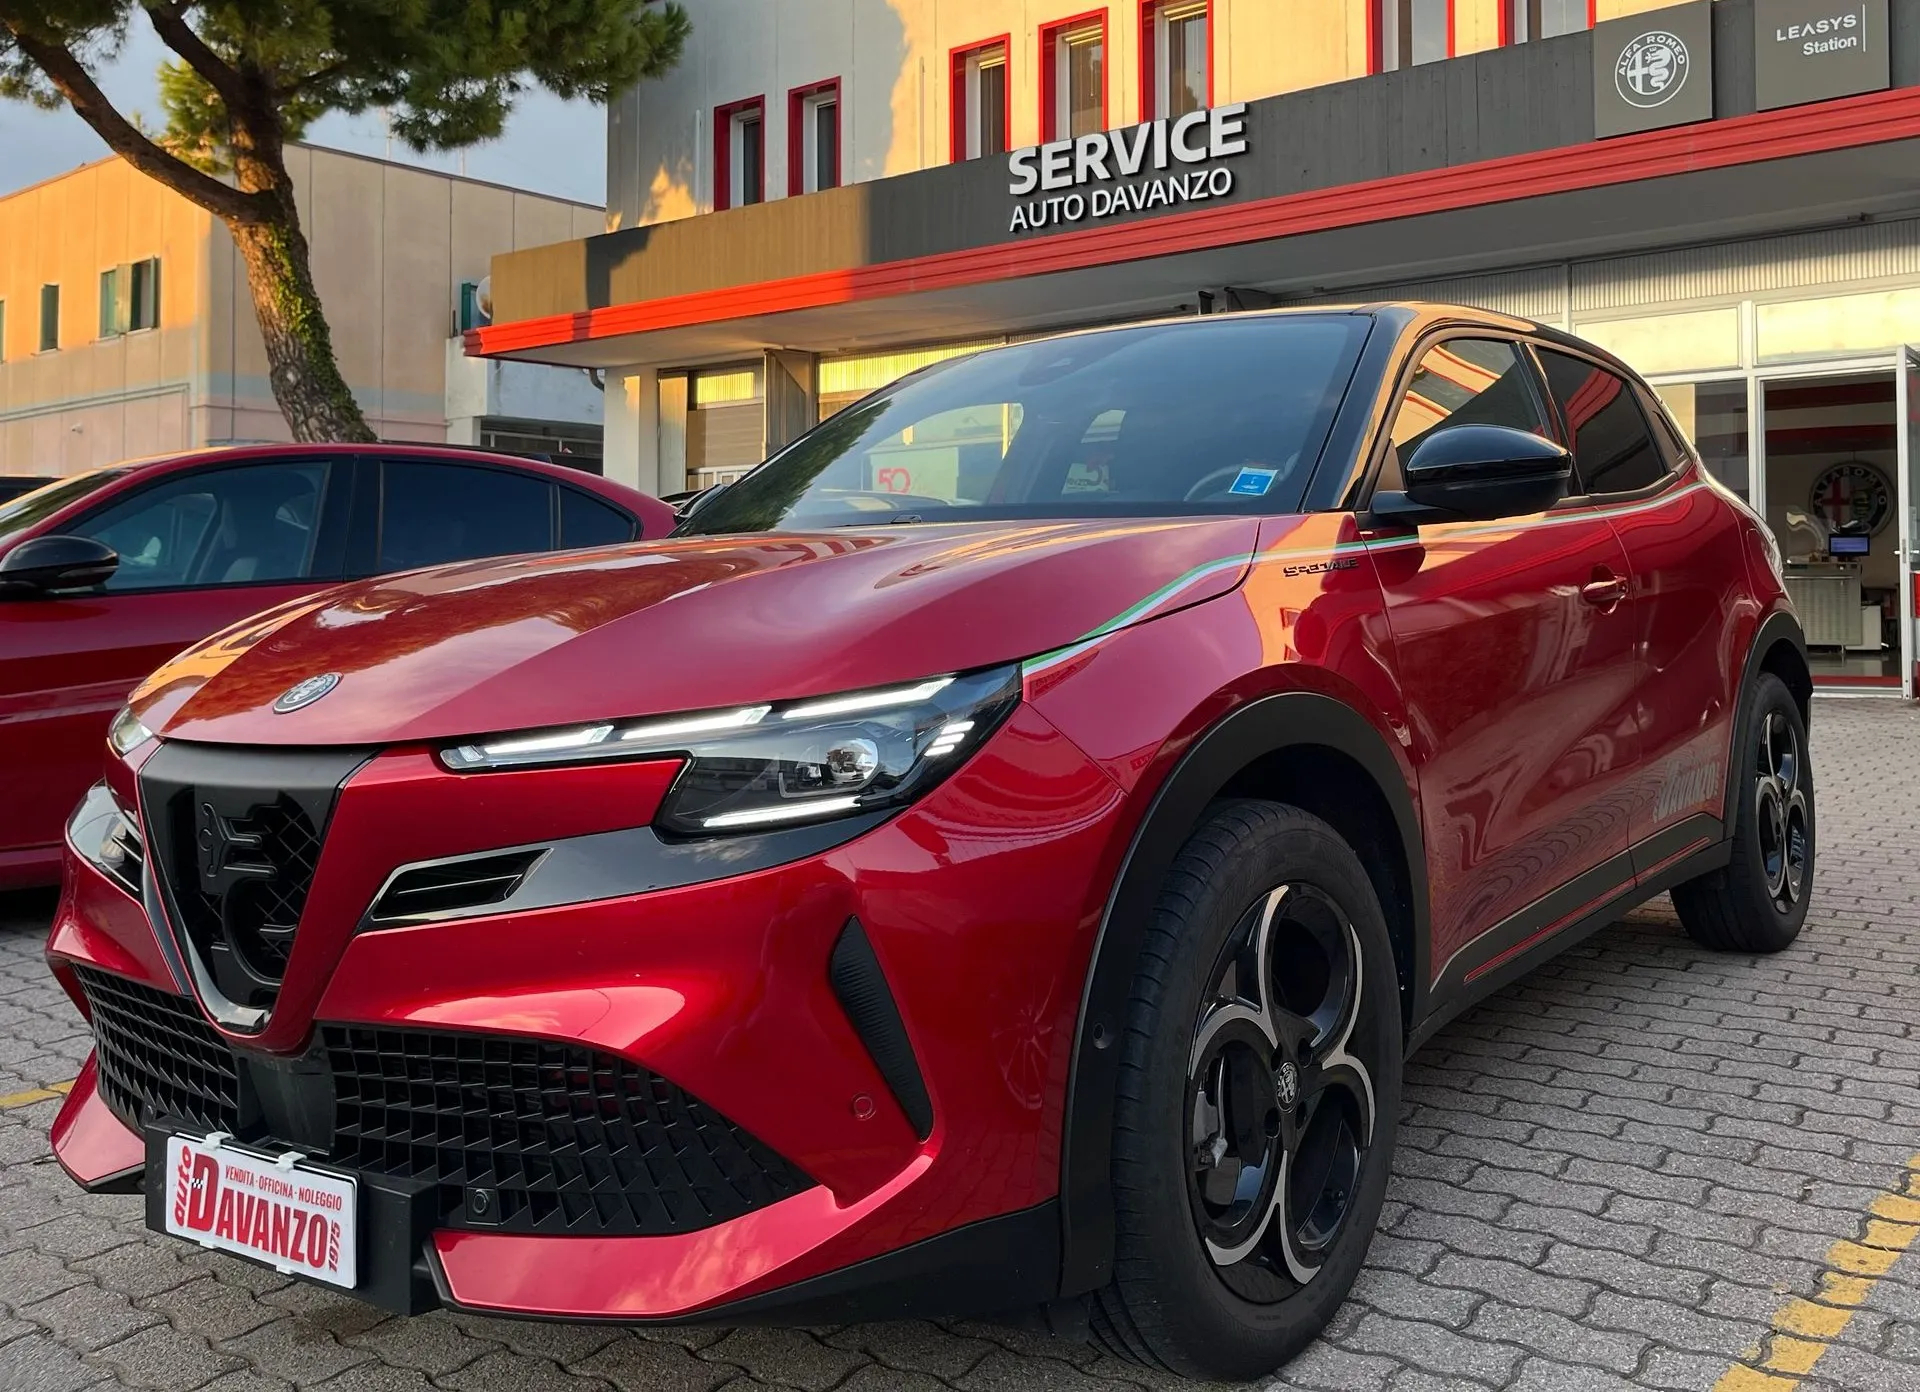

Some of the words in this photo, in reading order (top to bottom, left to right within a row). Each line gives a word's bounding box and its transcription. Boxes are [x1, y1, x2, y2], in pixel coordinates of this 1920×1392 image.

[1776, 14, 1857, 42] LEASYS
[1802, 35, 1857, 56] Station
[1619, 43, 1641, 76] ALFA
[1646, 35, 1685, 65] ROMEO
[1008, 102, 1247, 195] SERVICE
[1009, 194, 1085, 232] AUTO
[1092, 168, 1233, 217] DAVANZO
[174, 1145, 192, 1227] auto
[187, 1152, 329, 1268] DAVANZO
[225, 1164, 254, 1187] VENDITA
[258, 1179, 294, 1200] OFFICINA
[298, 1187, 342, 1211] NOLEGGIO
[328, 1220, 341, 1273] 1975
